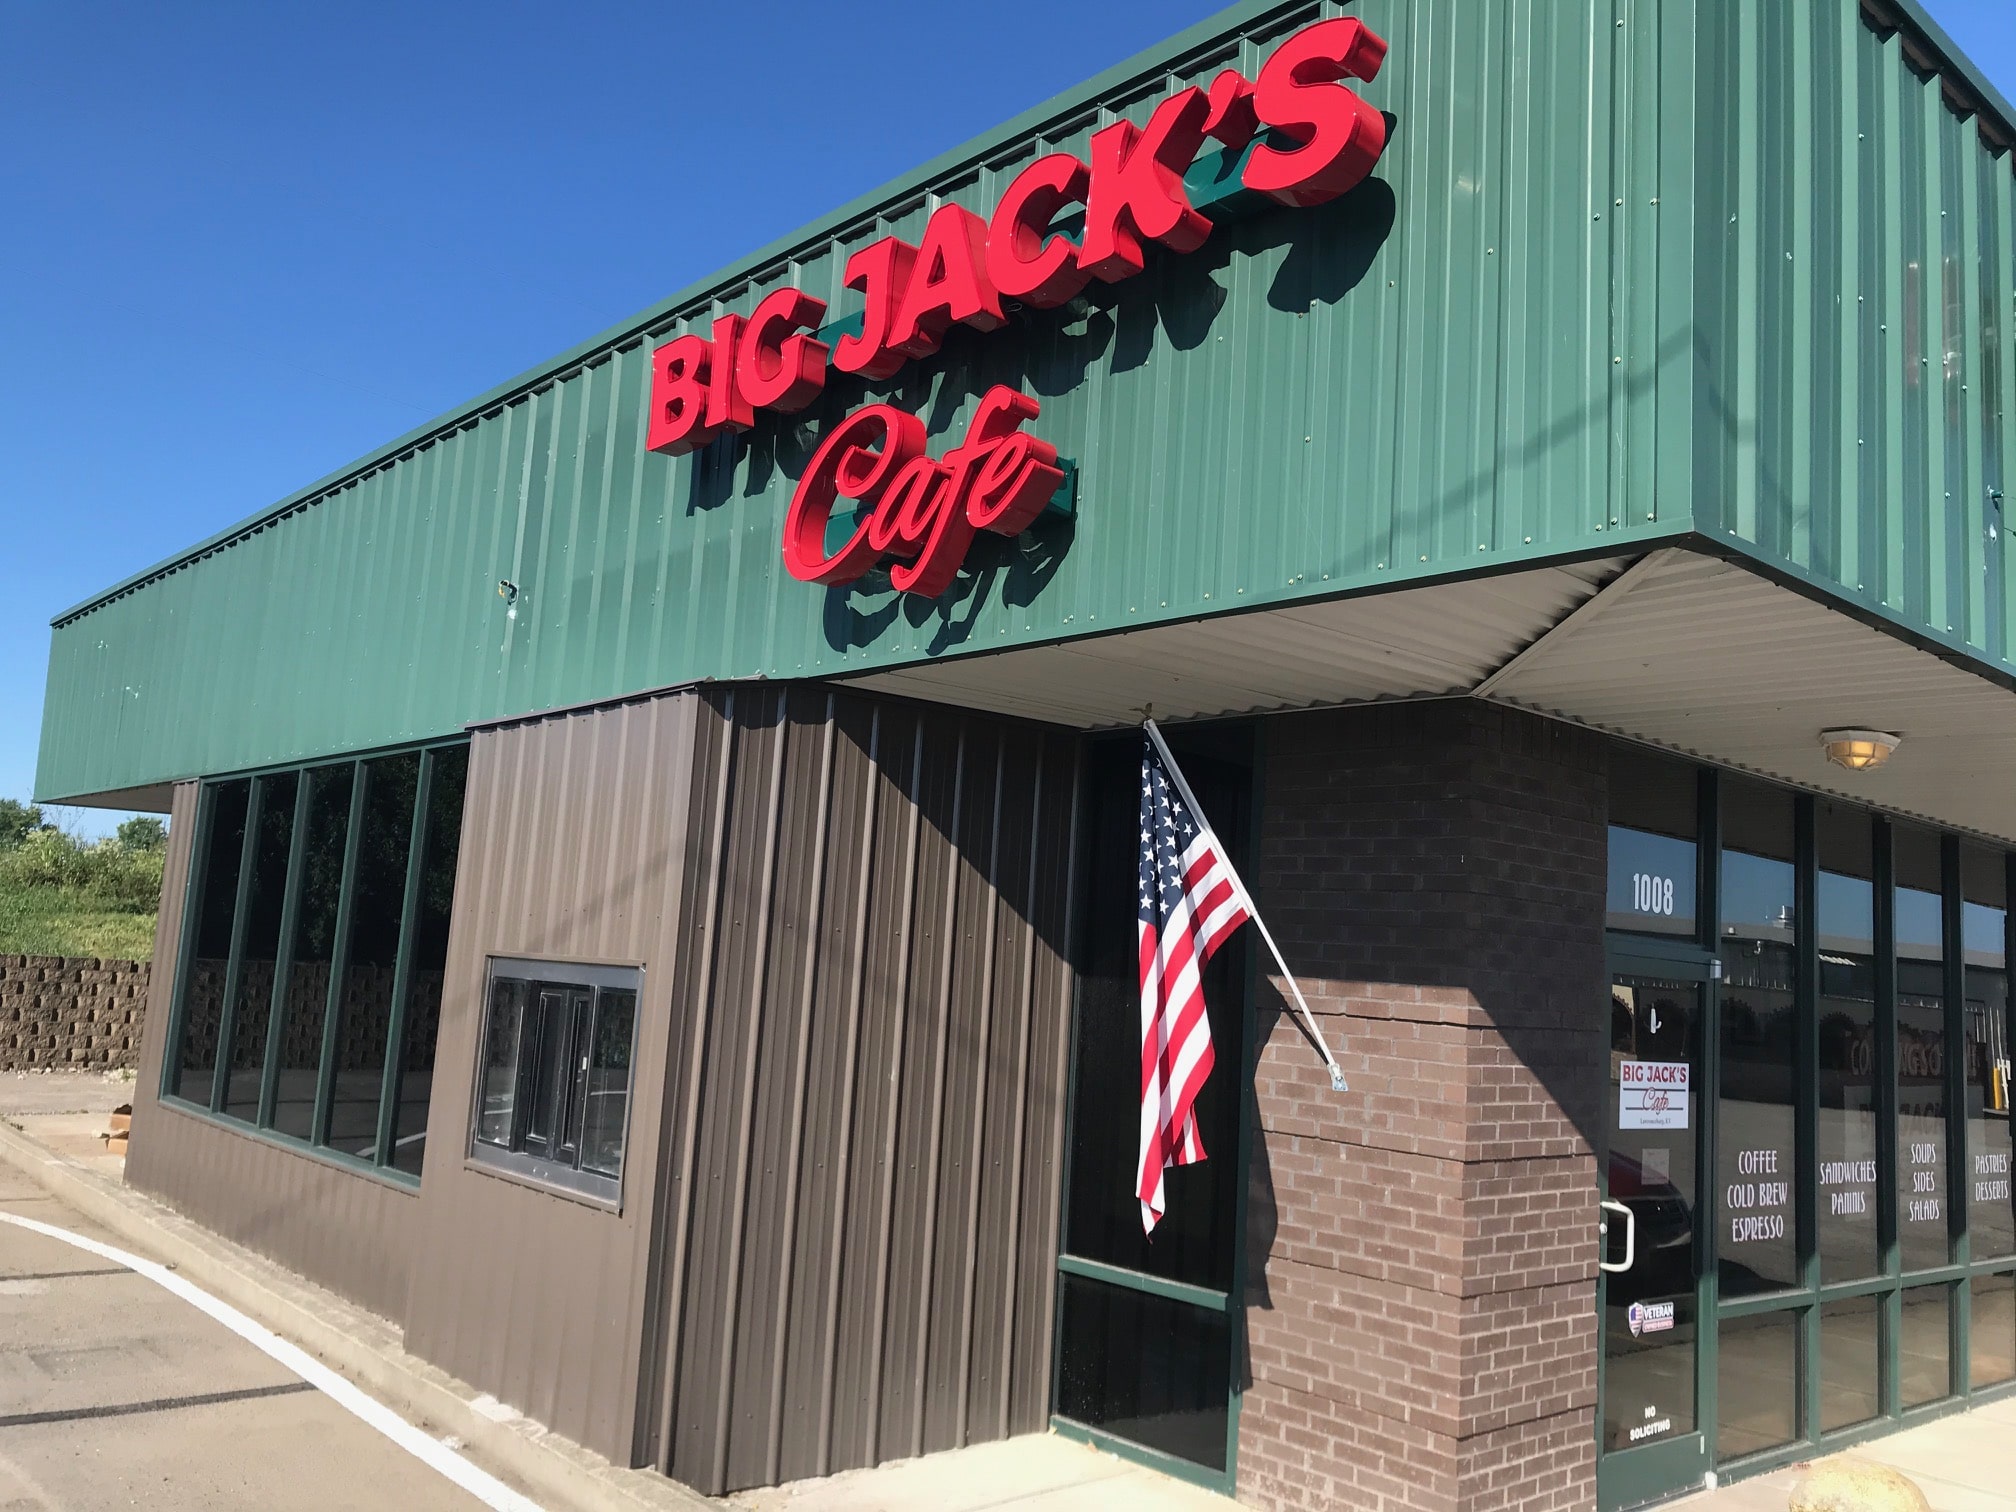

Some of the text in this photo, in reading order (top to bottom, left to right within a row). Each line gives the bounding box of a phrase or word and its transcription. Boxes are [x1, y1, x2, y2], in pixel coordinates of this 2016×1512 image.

[646, 17, 1387, 455] BIG JACK'S
[1633, 872, 1673, 915] 1008
[1623, 1065, 1687, 1083] BIG JACK'S
[1738, 1150, 1778, 1174] COFFEE
[1911, 1143, 1936, 1164] SOUPS
[1975, 1154, 2007, 1175] PASTRIES
[1819, 1160, 1877, 1184] SANDWICHES
[1913, 1171, 1935, 1192] SIDES
[1727, 1182, 1788, 1208] COLD BREW
[1975, 1180, 2009, 1202] DESSERTS
[1831, 1191, 1865, 1215] PANINIS
[1909, 1199, 1940, 1222] SALADS
[1732, 1215, 1784, 1242] ESPRESSO
[1644, 1304, 1673, 1320] VETERAN
[1645, 1406, 1656, 1418] NO
[1630, 1419, 1671, 1441] SOLICITING
